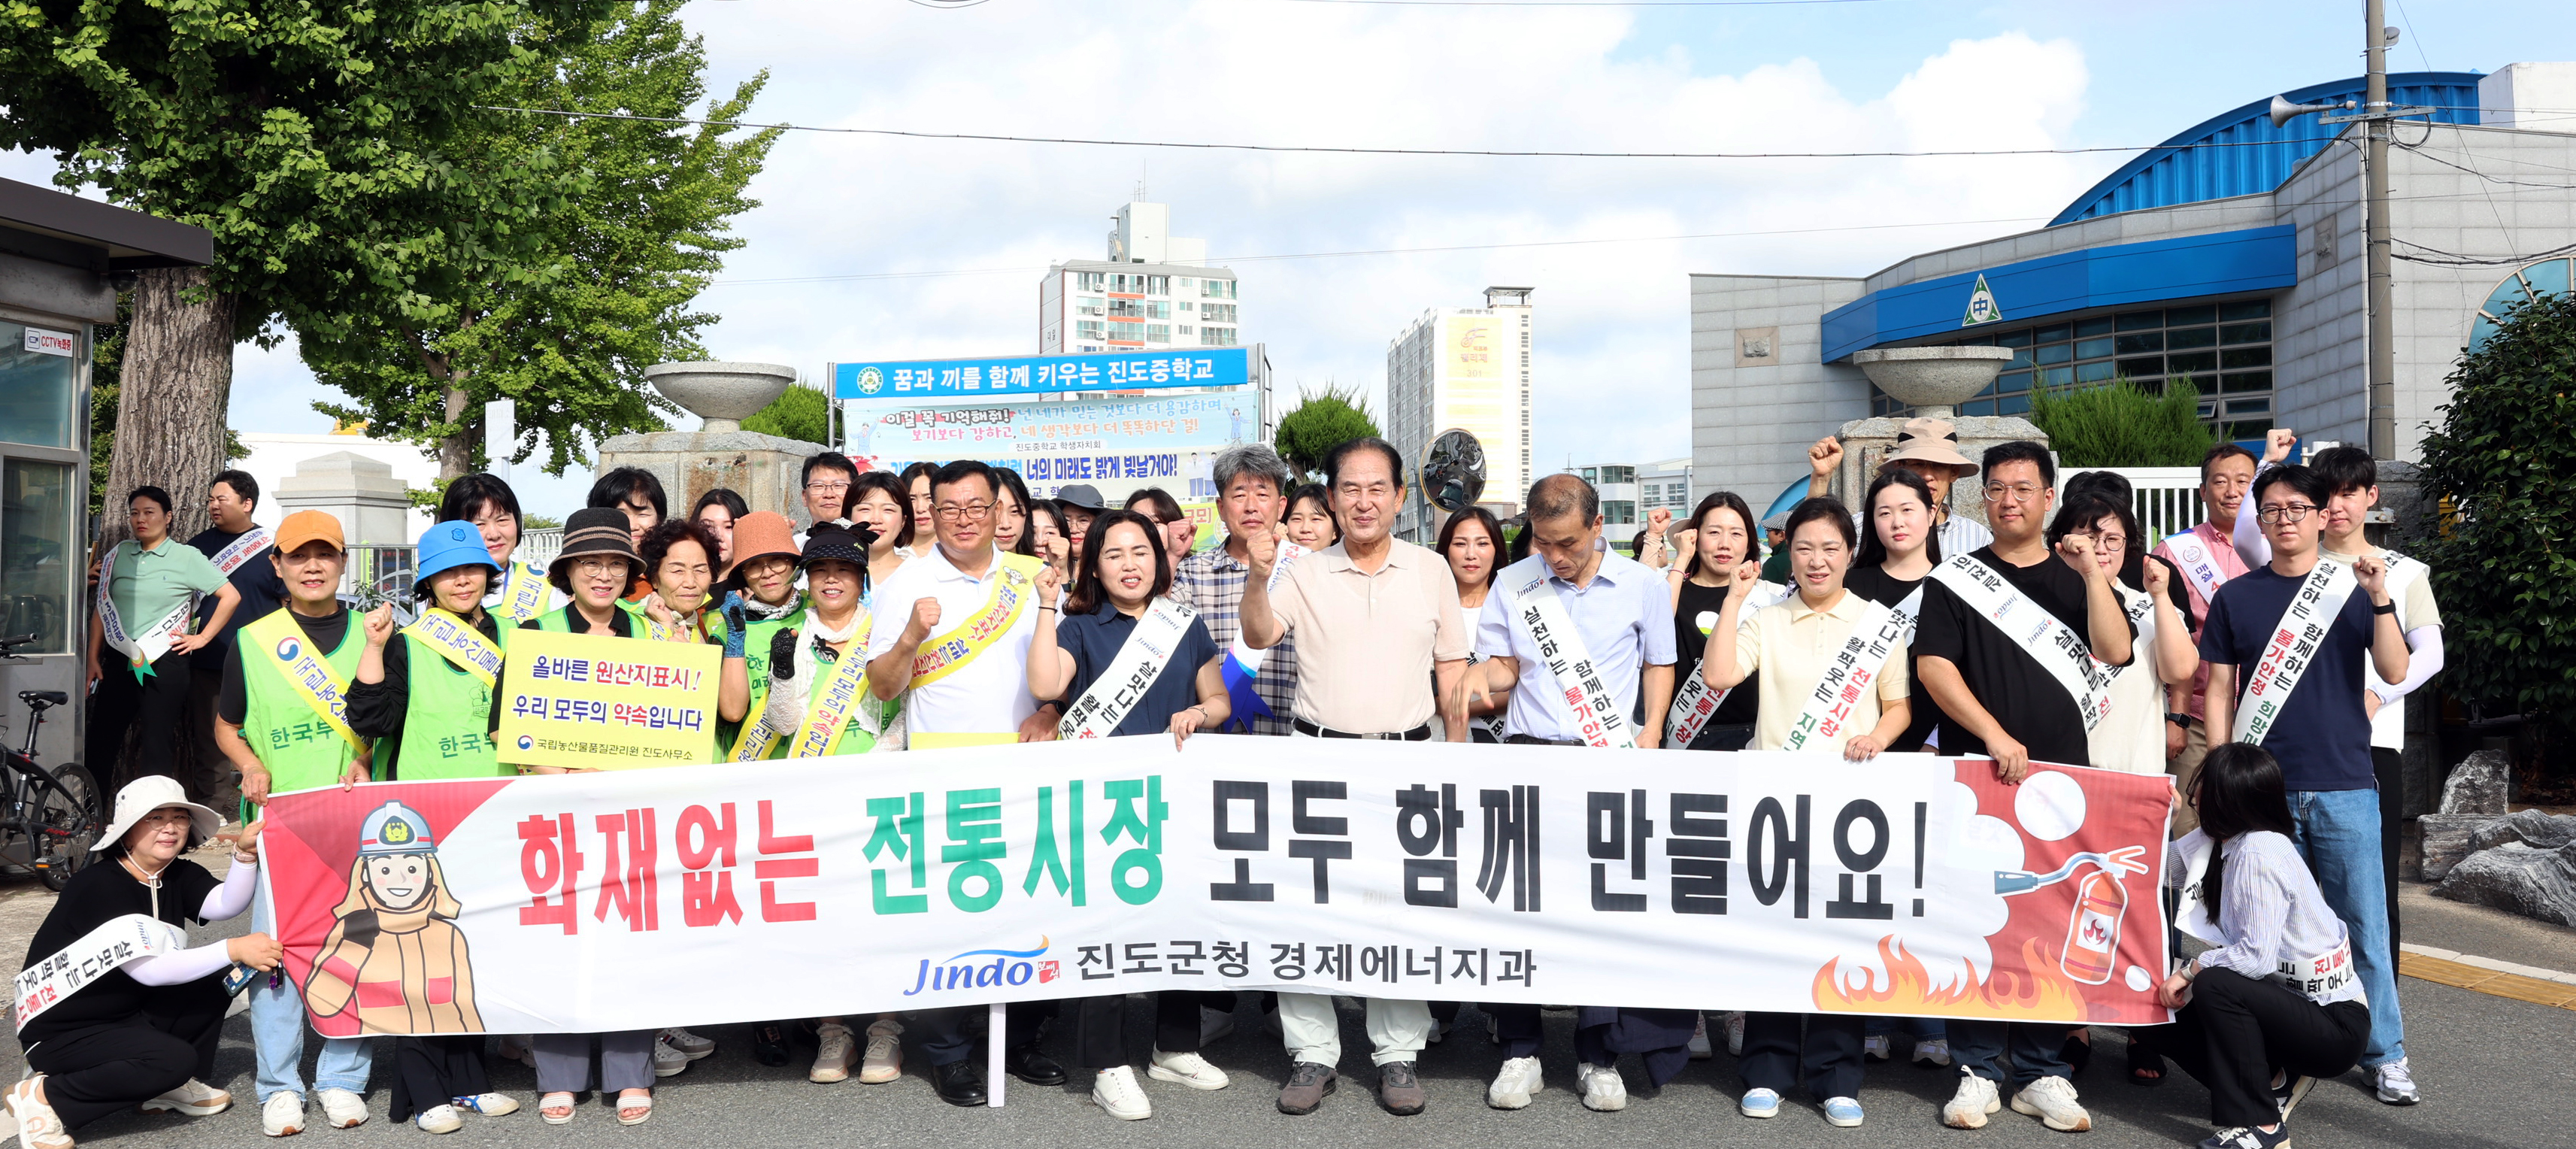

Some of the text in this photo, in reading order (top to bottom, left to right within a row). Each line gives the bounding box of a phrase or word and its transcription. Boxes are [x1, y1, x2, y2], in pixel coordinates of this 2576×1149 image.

[41, 335, 71, 350] CCTV녹화중
[893, 358, 1214, 392] 꿈과 끼를 함께 키우는 진도중학교
[1467, 369, 1482, 377] 301
[885, 399, 1222, 429] 이걸 꼭 기억해줘! 넌 네가 믿는 것보다 더 용감하며
[911, 417, 1199, 442] 보기보다 강하고, 네 생각보다 더 똑똑하단 걸!
[1015, 441, 1101, 452] 진도중학교 학생자치회
[1026, 457, 1051, 481] 너의
[1054, 457, 1091, 481] 미래도
[1096, 456, 1120, 480] 밝게
[1124, 454, 1177, 479] 빛날거야!
[1516, 580, 1541, 601] Jindo
[1952, 554, 2002, 593] 실천하
[2195, 563, 2214, 583] 매월
[1523, 605, 1568, 677] 실천하는
[2250, 562, 2338, 697] 실천하는 물가안정
[532, 656, 702, 691] 올바른 원산지표시!
[2273, 623, 2323, 692] 함께하는
[1100, 659, 1157, 724] 살맛나는
[1573, 659, 1622, 731] 함께하는
[1784, 636, 1866, 751] 활짝웃는 지역
[1820, 667, 1871, 738] 전통시장
[513, 695, 703, 732] 우리 모두의 약속입니다
[537, 738, 692, 760] 국립농산물품질관리원 진도사무소
[517, 775, 1929, 935] 화재없는 전통시장 모두 함께 만들어요!
[14, 950, 69, 999] 활짝웃는
[65, 941, 134, 988] 살맛나는
[903, 957, 1034, 996] Jindo
[1077, 940, 1537, 987] 진도군청 경제에너지과
